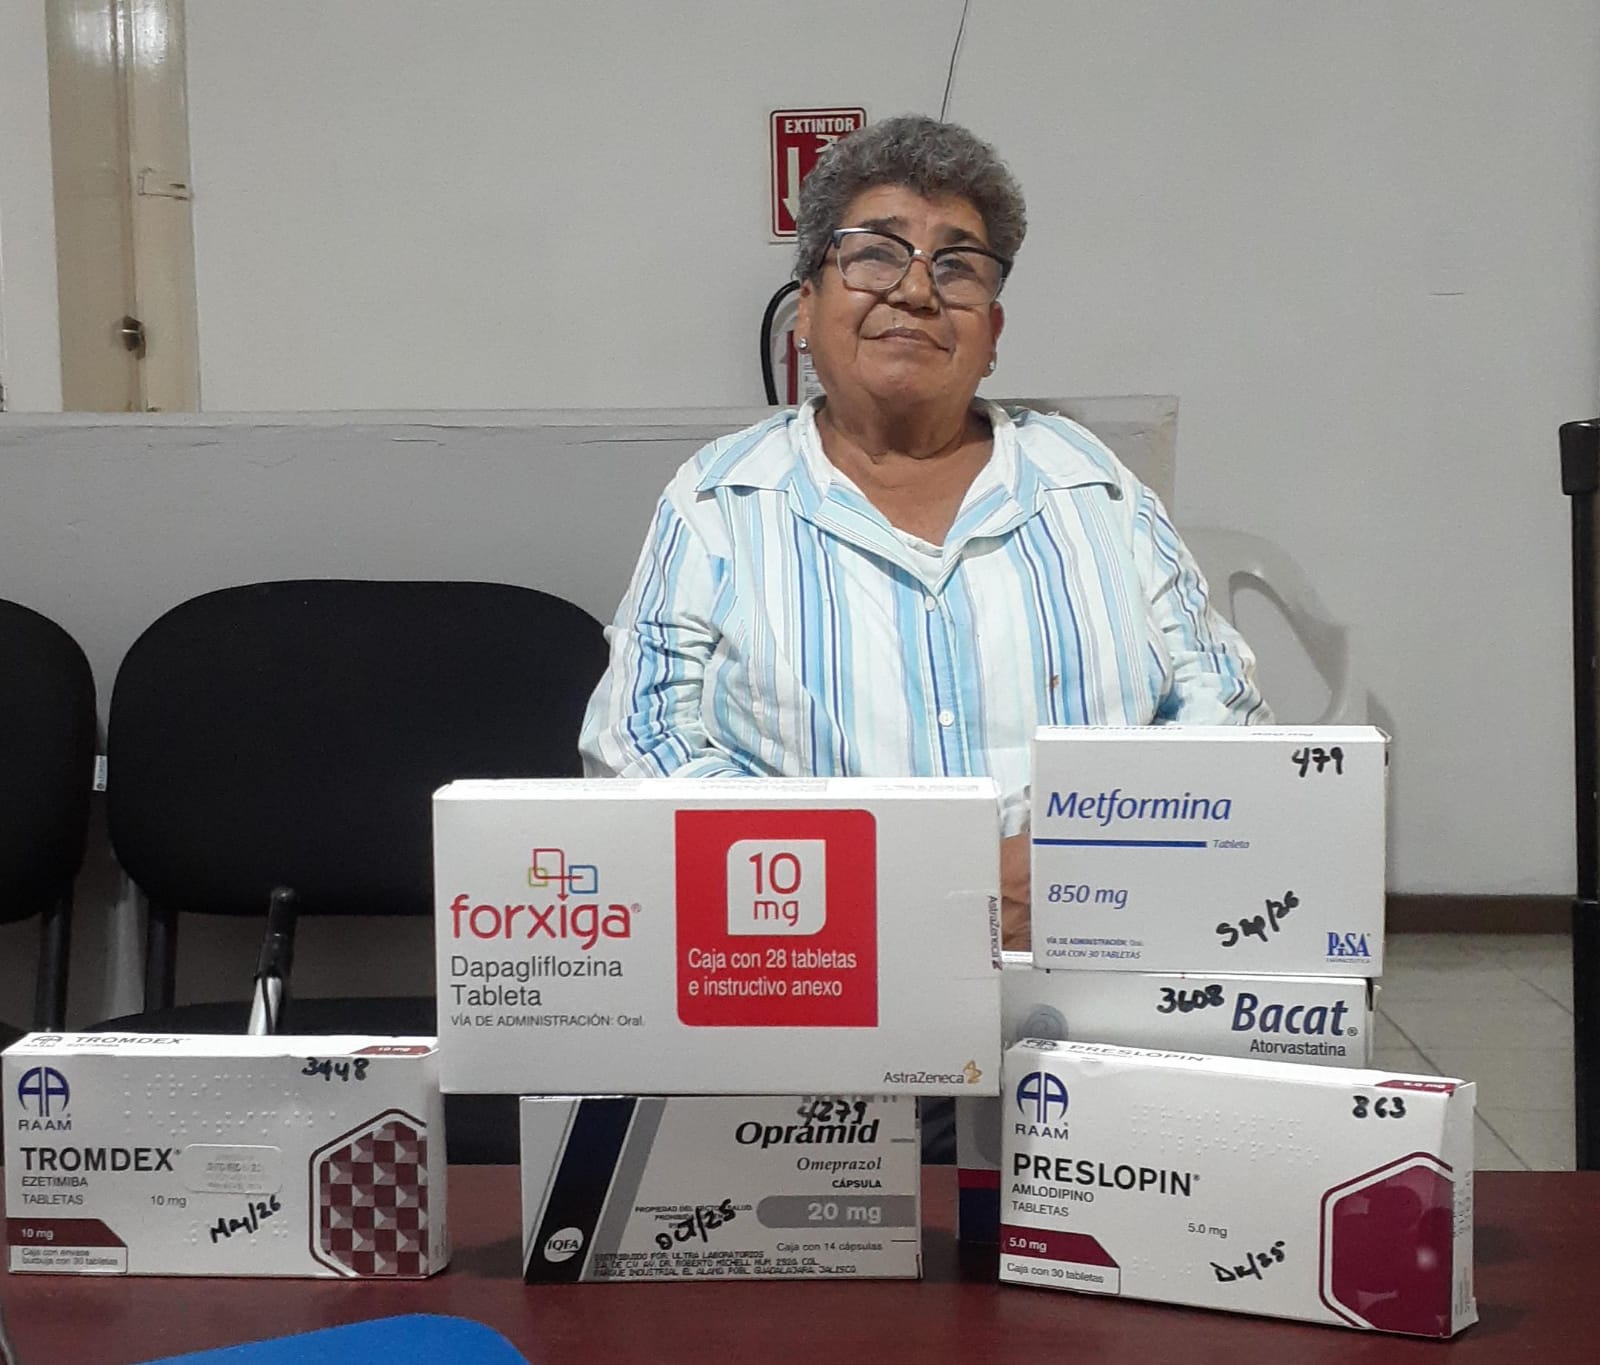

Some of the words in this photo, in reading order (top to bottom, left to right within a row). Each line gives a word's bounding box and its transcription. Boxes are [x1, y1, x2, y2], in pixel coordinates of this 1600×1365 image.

[785, 118, 855, 134] EXTINTOR
[1291, 746, 1344, 778] 479
[1046, 788, 1232, 827] Metformina
[1212, 839, 1250, 849] Tableta
[749, 852, 802, 895] 10
[1047, 884, 1091, 903] 850
[1095, 889, 1128, 910] mg
[753, 900, 799, 927] mg
[688, 948, 726, 972] Caja
[731, 952, 760, 968] con
[766, 950, 787, 968] 28
[791, 948, 857, 968] tabletas
[1046, 949, 1066, 957] CAJA
[1067, 950, 1086, 958] CON
[1087, 951, 1100, 959] 30
[1101, 950, 1141, 960] TABLETAS
[451, 956, 622, 982] Dapagliflozina
[688, 981, 699, 996] e
[704, 977, 787, 996] instructivo
[791, 981, 842, 996] anexo
[450, 985, 542, 1006] Tableta
[451, 1012, 471, 1026] VÍA
[476, 1015, 493, 1026] DE
[497, 1012, 613, 1026] ADMINISTRACIÓN:
[1250, 1038, 1347, 1057] Atorvastatina
[884, 1071, 964, 1085] AstraZeneca
[1352, 1095, 1406, 1119] 863
[18, 1120, 72, 1131] RAAM
[1015, 1124, 1069, 1140] RAAM
[735, 1119, 880, 1149] Opramid
[796, 1157, 882, 1174] Omeprazol
[22, 1176, 88, 1187] EZETIMIBA
[832, 1177, 882, 1188] CÁPSULA
[22, 1193, 83, 1205] TABLETAS
[1012, 1183, 1094, 1203] AMLODIPINO
[151, 1195, 165, 1206] 10
[167, 1198, 186, 1208] mg
[635, 1205, 677, 1213] PROPIEDAD
[679, 1204, 693, 1212] DEL
[1012, 1200, 1069, 1217] TABLETAS
[807, 1202, 839, 1221] 20
[847, 1206, 882, 1225] mg
[21, 1228, 35, 1238] 10
[36, 1230, 54, 1241] mg
[1187, 1223, 1206, 1234] 5.0
[1208, 1226, 1228, 1239] mg
[22, 1247, 40, 1258] Caja
[547, 1239, 579, 1251] IQFA
[776, 1242, 800, 1253] Caja
[802, 1243, 821, 1251] con
[824, 1242, 835, 1250] 14
[838, 1242, 883, 1252] cápsulas
[1009, 1237, 1027, 1248] 5.0
[1029, 1241, 1048, 1253] mg
[73, 1257, 83, 1266] 30
[86, 1257, 118, 1266] tabletas
[672, 1252, 699, 1260] ULTRA
[702, 1251, 764, 1259] LABORATORIOS
[675, 1259, 714, 1267] ROBERTO
[818, 1264, 857, 1274] JALISCO
[1007, 1262, 1029, 1276] Caja
[1031, 1267, 1049, 1276] con
[1051, 1268, 1064, 1279] 30
[1066, 1269, 1104, 1285] tabletas
